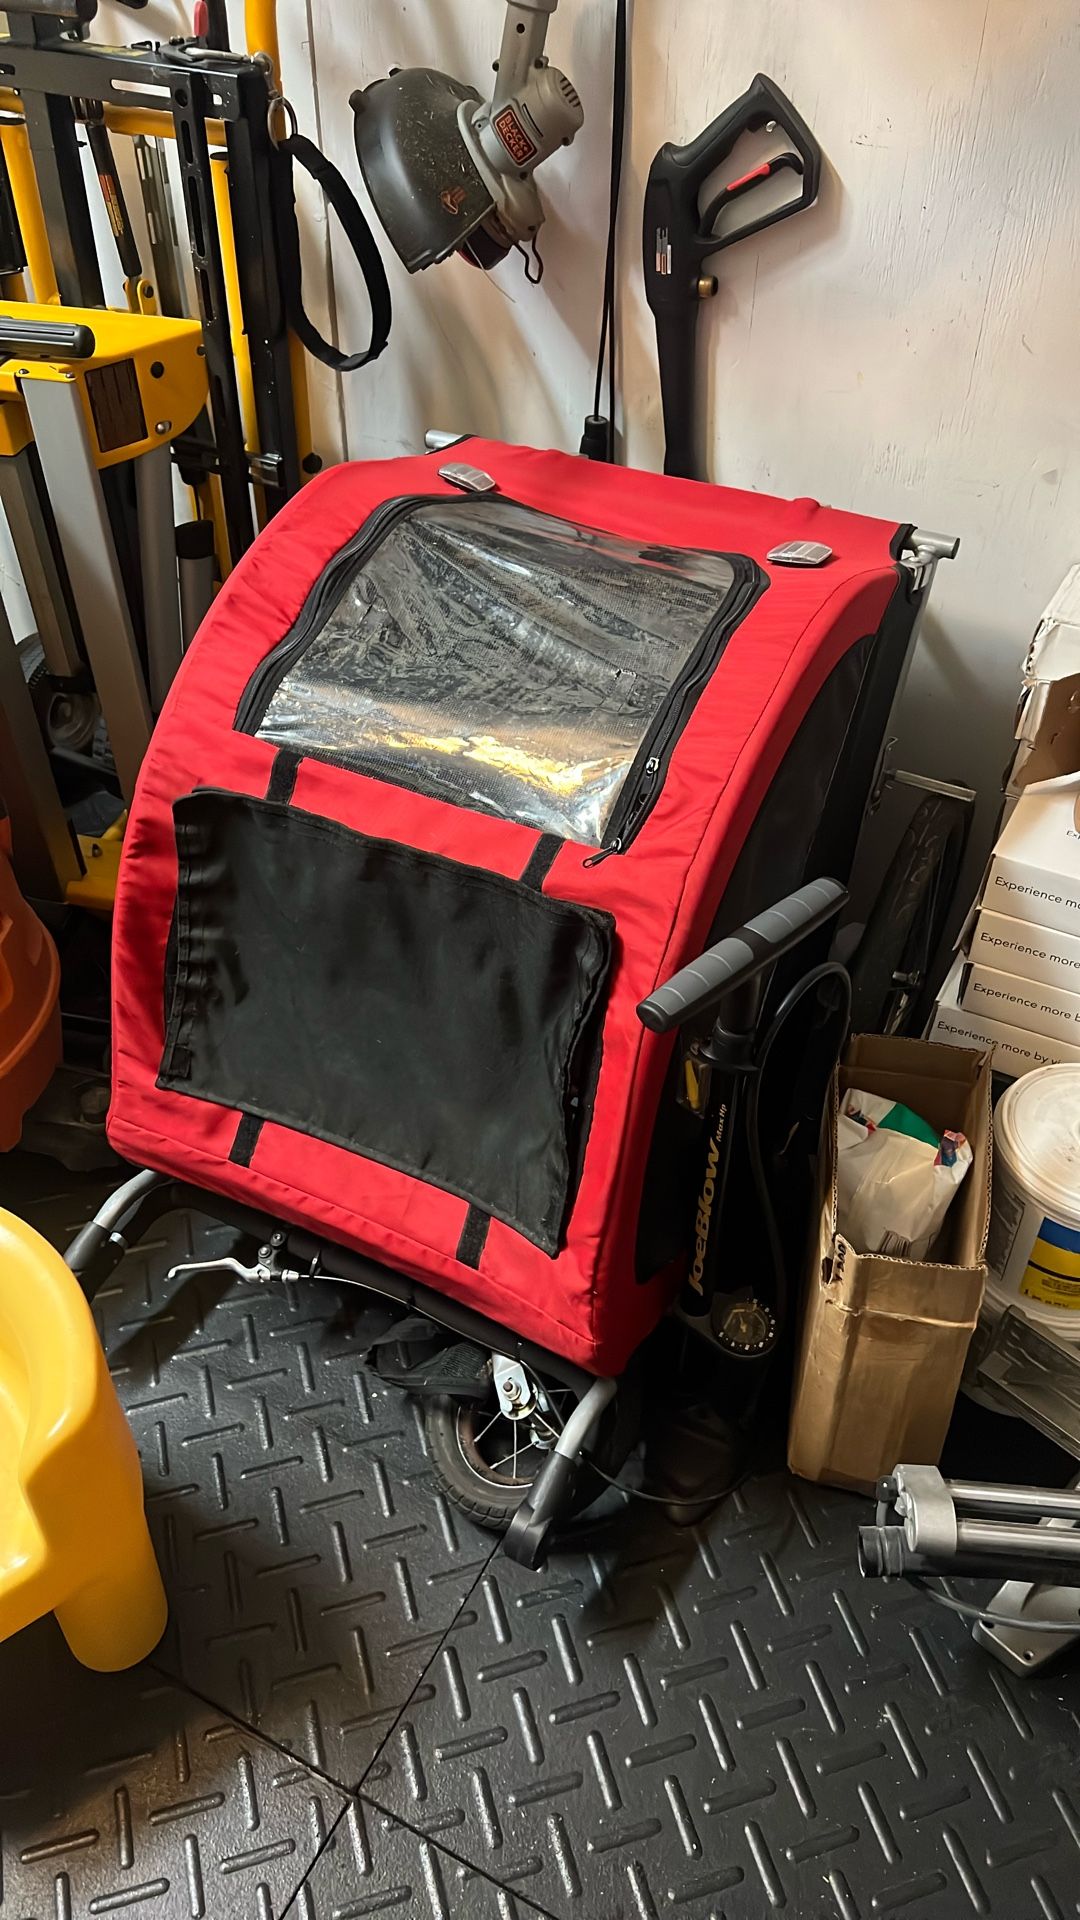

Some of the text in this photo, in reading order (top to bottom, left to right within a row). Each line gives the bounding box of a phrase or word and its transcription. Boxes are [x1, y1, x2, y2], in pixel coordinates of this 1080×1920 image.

[499, 120, 523, 157] DECKER
[995, 876, 1062, 904] Experience
[980, 932, 1080, 969] Experience more
[973, 983, 1038, 1009] Experience
[1040, 1004, 1071, 1020] more
[937, 1020, 998, 1045] Experience
[1001, 1043, 1031, 1058] more
[1034, 1051, 1049, 1064] by
[716, 1117, 725, 1142] Max
